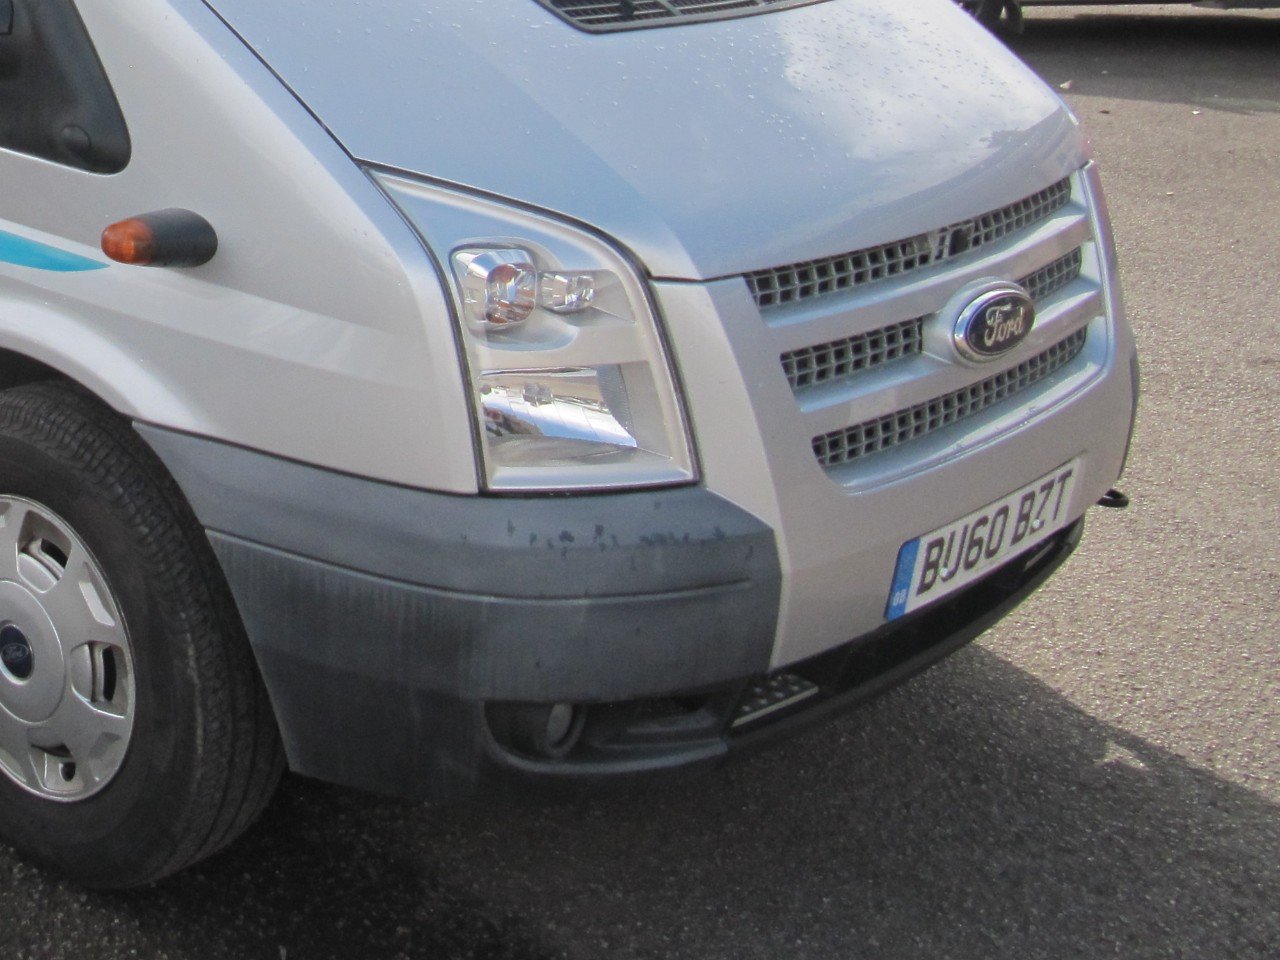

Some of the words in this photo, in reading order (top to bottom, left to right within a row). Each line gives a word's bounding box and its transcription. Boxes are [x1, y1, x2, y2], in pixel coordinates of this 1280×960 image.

[983, 302, 1024, 347] Ford
[916, 504, 1010, 596] BU60
[1010, 468, 1074, 547] BZT
